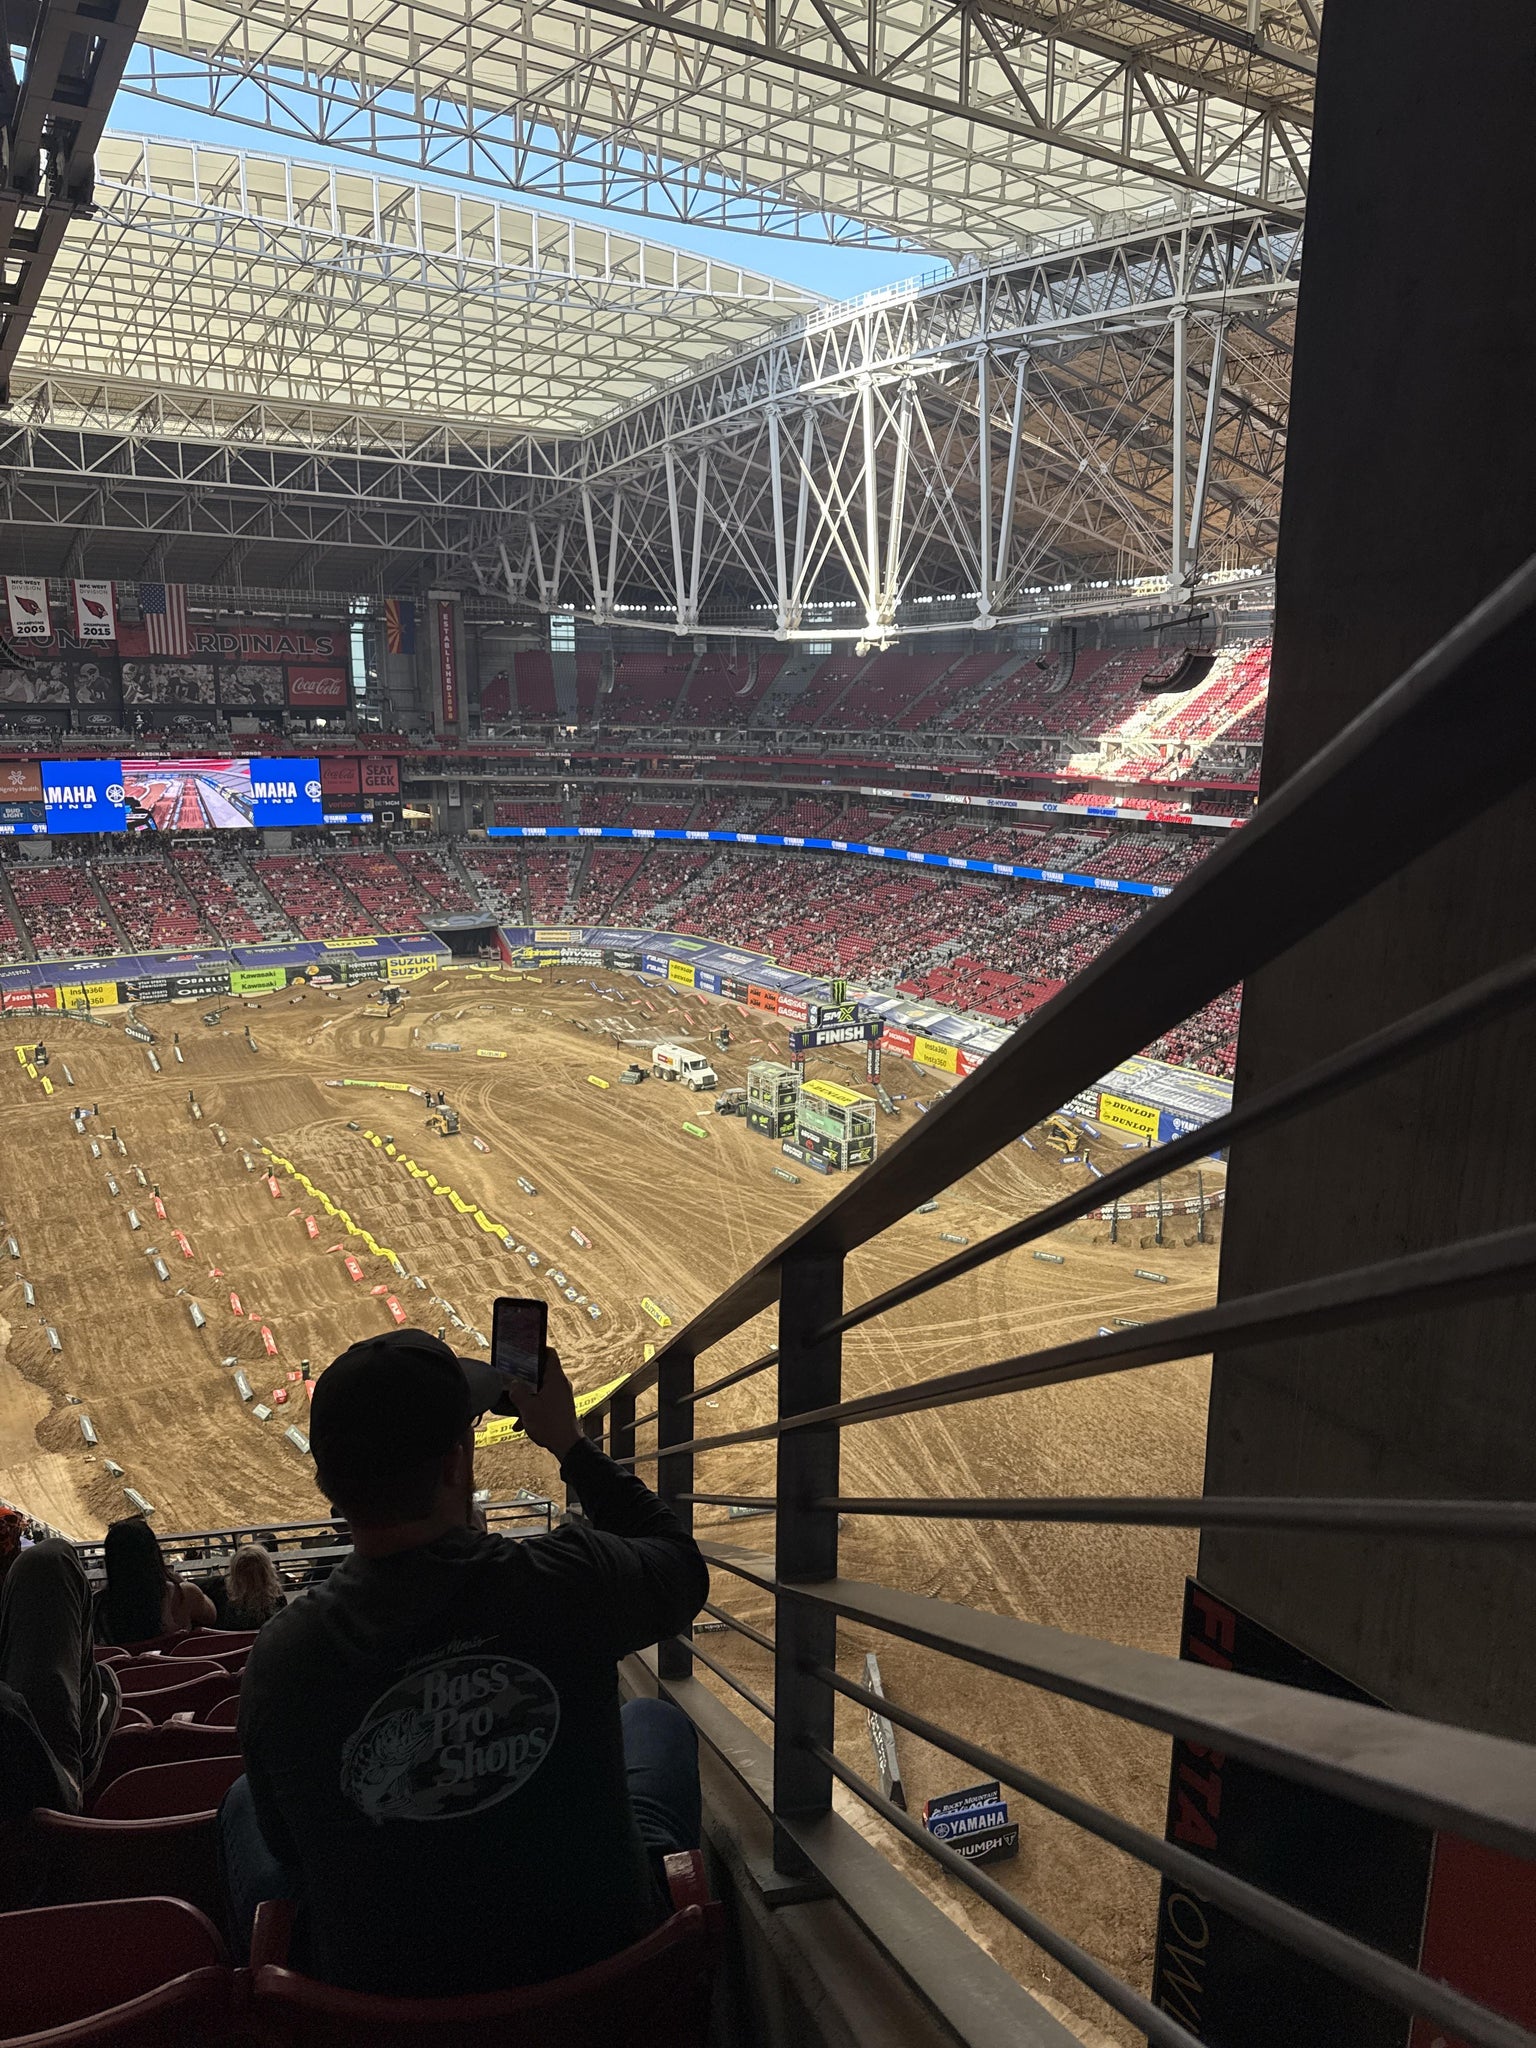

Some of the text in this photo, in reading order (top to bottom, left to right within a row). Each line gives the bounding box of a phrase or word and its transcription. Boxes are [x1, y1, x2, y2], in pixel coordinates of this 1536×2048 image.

[17, 625, 46, 634] 2009
[83, 627, 111, 636] 2015
[443, 613, 453, 691] ESTABLISHED
[366, 765, 393, 775] SEAT
[365, 775, 396, 787] GEEK
[329, 801, 356, 809] verizon
[1043, 803, 1059, 811] COX
[392, 956, 435, 966] SUZUKI
[191, 975, 229, 984] OAKLEY
[240, 971, 276, 980] Kawasaki
[70, 987, 103, 996] Insa360
[242, 980, 277, 990] Kawasaki
[12, 993, 49, 1001] HONDA
[71, 997, 104, 1007] In360
[778, 995, 807, 1009] GASGAS
[778, 1006, 807, 1020] GASGAS
[822, 1005, 856, 1023] SMX
[816, 1025, 865, 1046] FINISH
[888, 1032, 911, 1044] HONDA
[888, 1044, 911, 1056] HONDA
[924, 1042, 948, 1055] Insta360
[923, 1054, 947, 1068] Insta360
[812, 1084, 853, 1103] DUNLOP
[1112, 1101, 1156, 1119] DUNLOP
[1111, 1115, 1155, 1133] DUNLOP
[423, 1662, 509, 1716] Bass
[1173, 1588, 1236, 1850] FITA
[432, 1706, 494, 1751] Pro
[436, 1727, 548, 1788] Shops
[943, 1800, 964, 1812] ROCKY
[964, 1791, 998, 1804] MOUNTAIN
[950, 1811, 1005, 1835] YAMAHA
[1160, 1878, 1209, 2036] OWL
